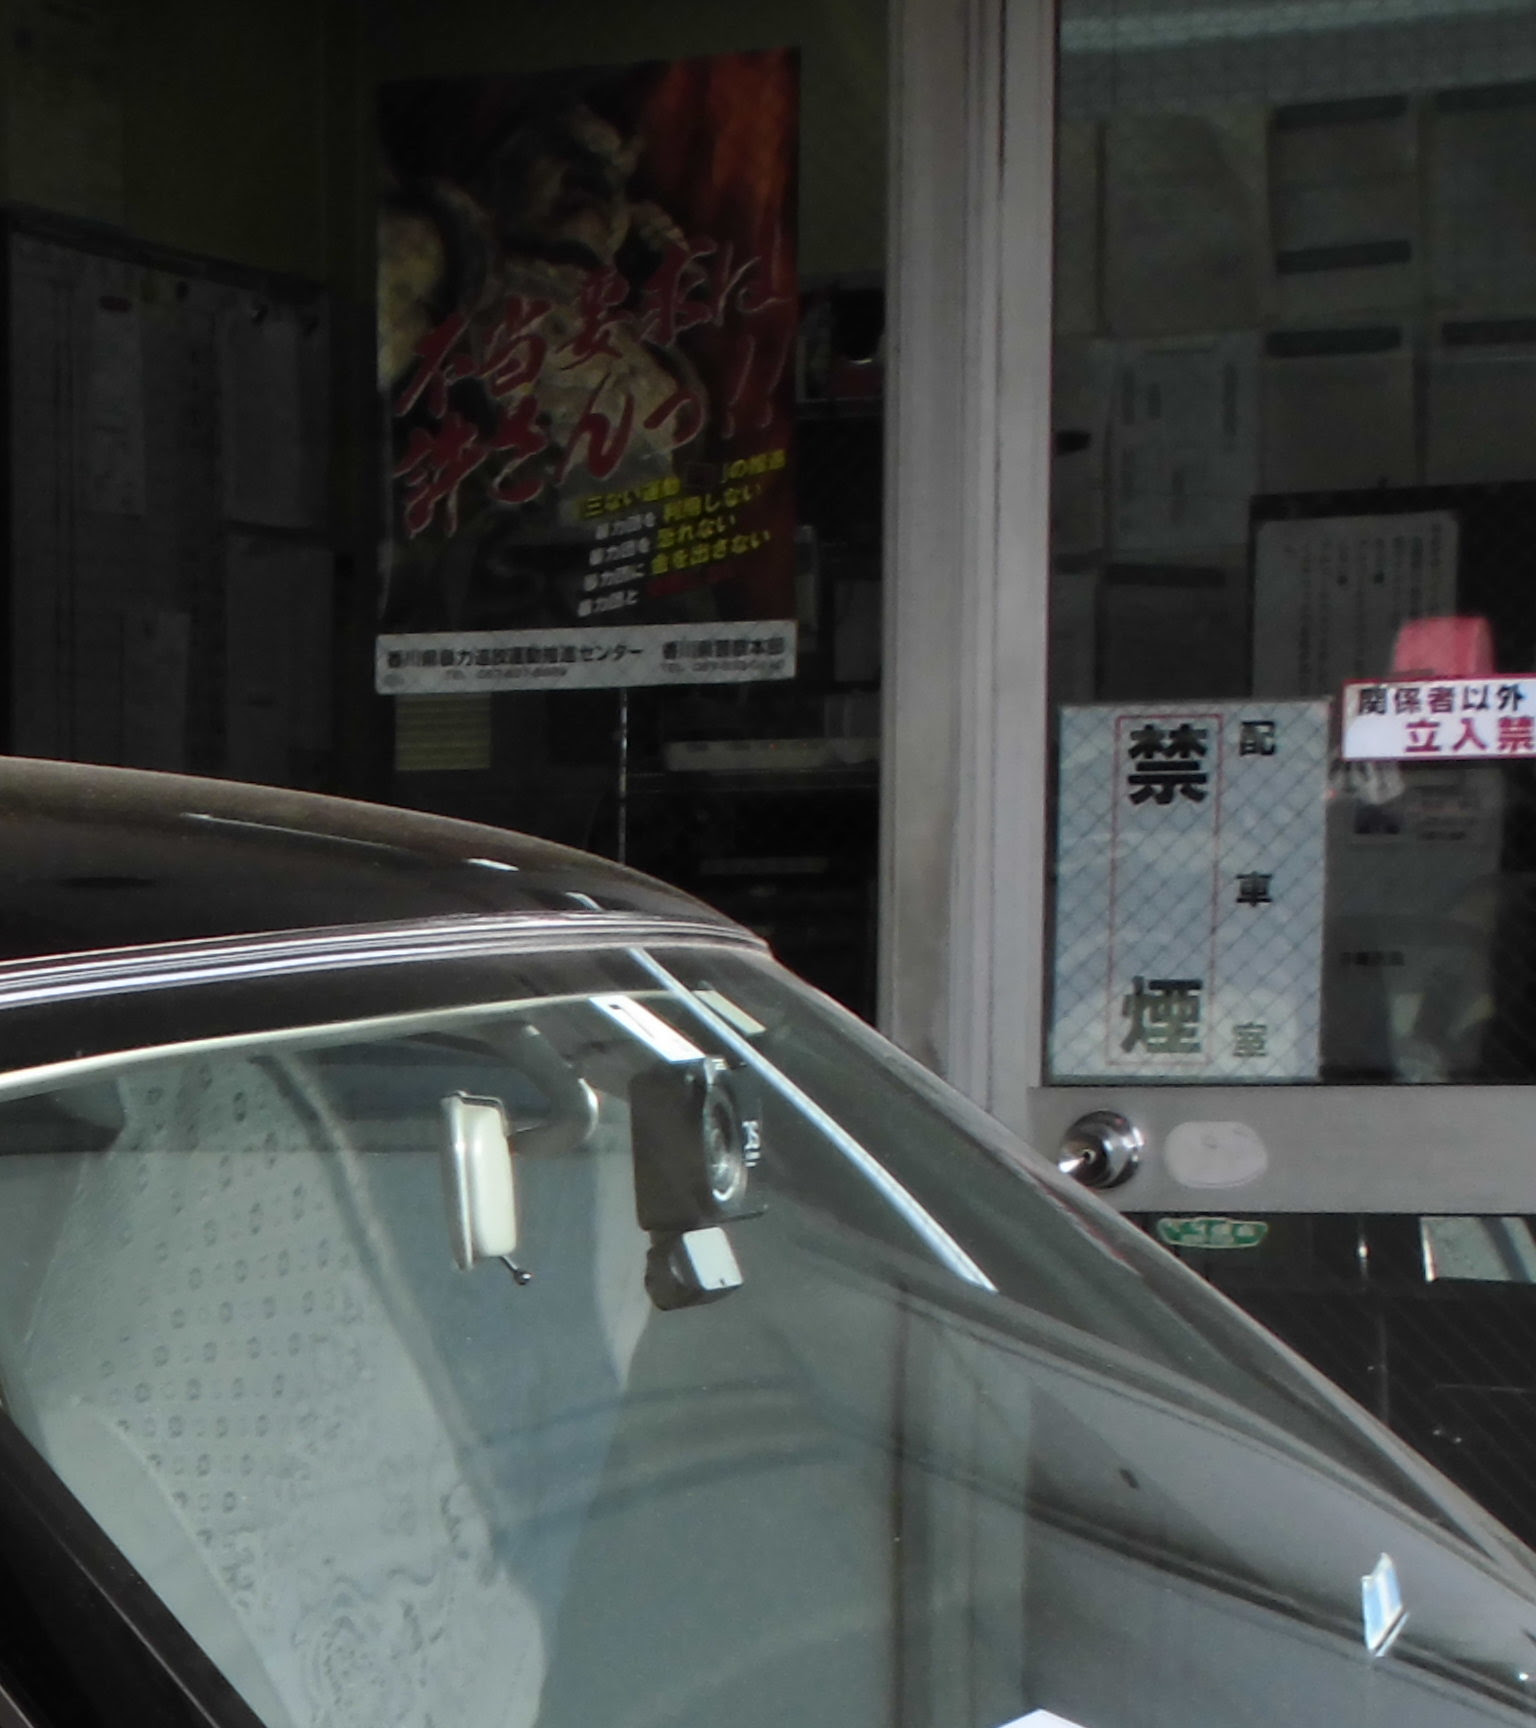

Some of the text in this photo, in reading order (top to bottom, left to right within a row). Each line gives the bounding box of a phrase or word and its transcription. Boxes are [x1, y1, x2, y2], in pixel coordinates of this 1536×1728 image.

[1358, 684, 1525, 715] 関係者以外
[1121, 722, 1209, 1054] 禁煙
